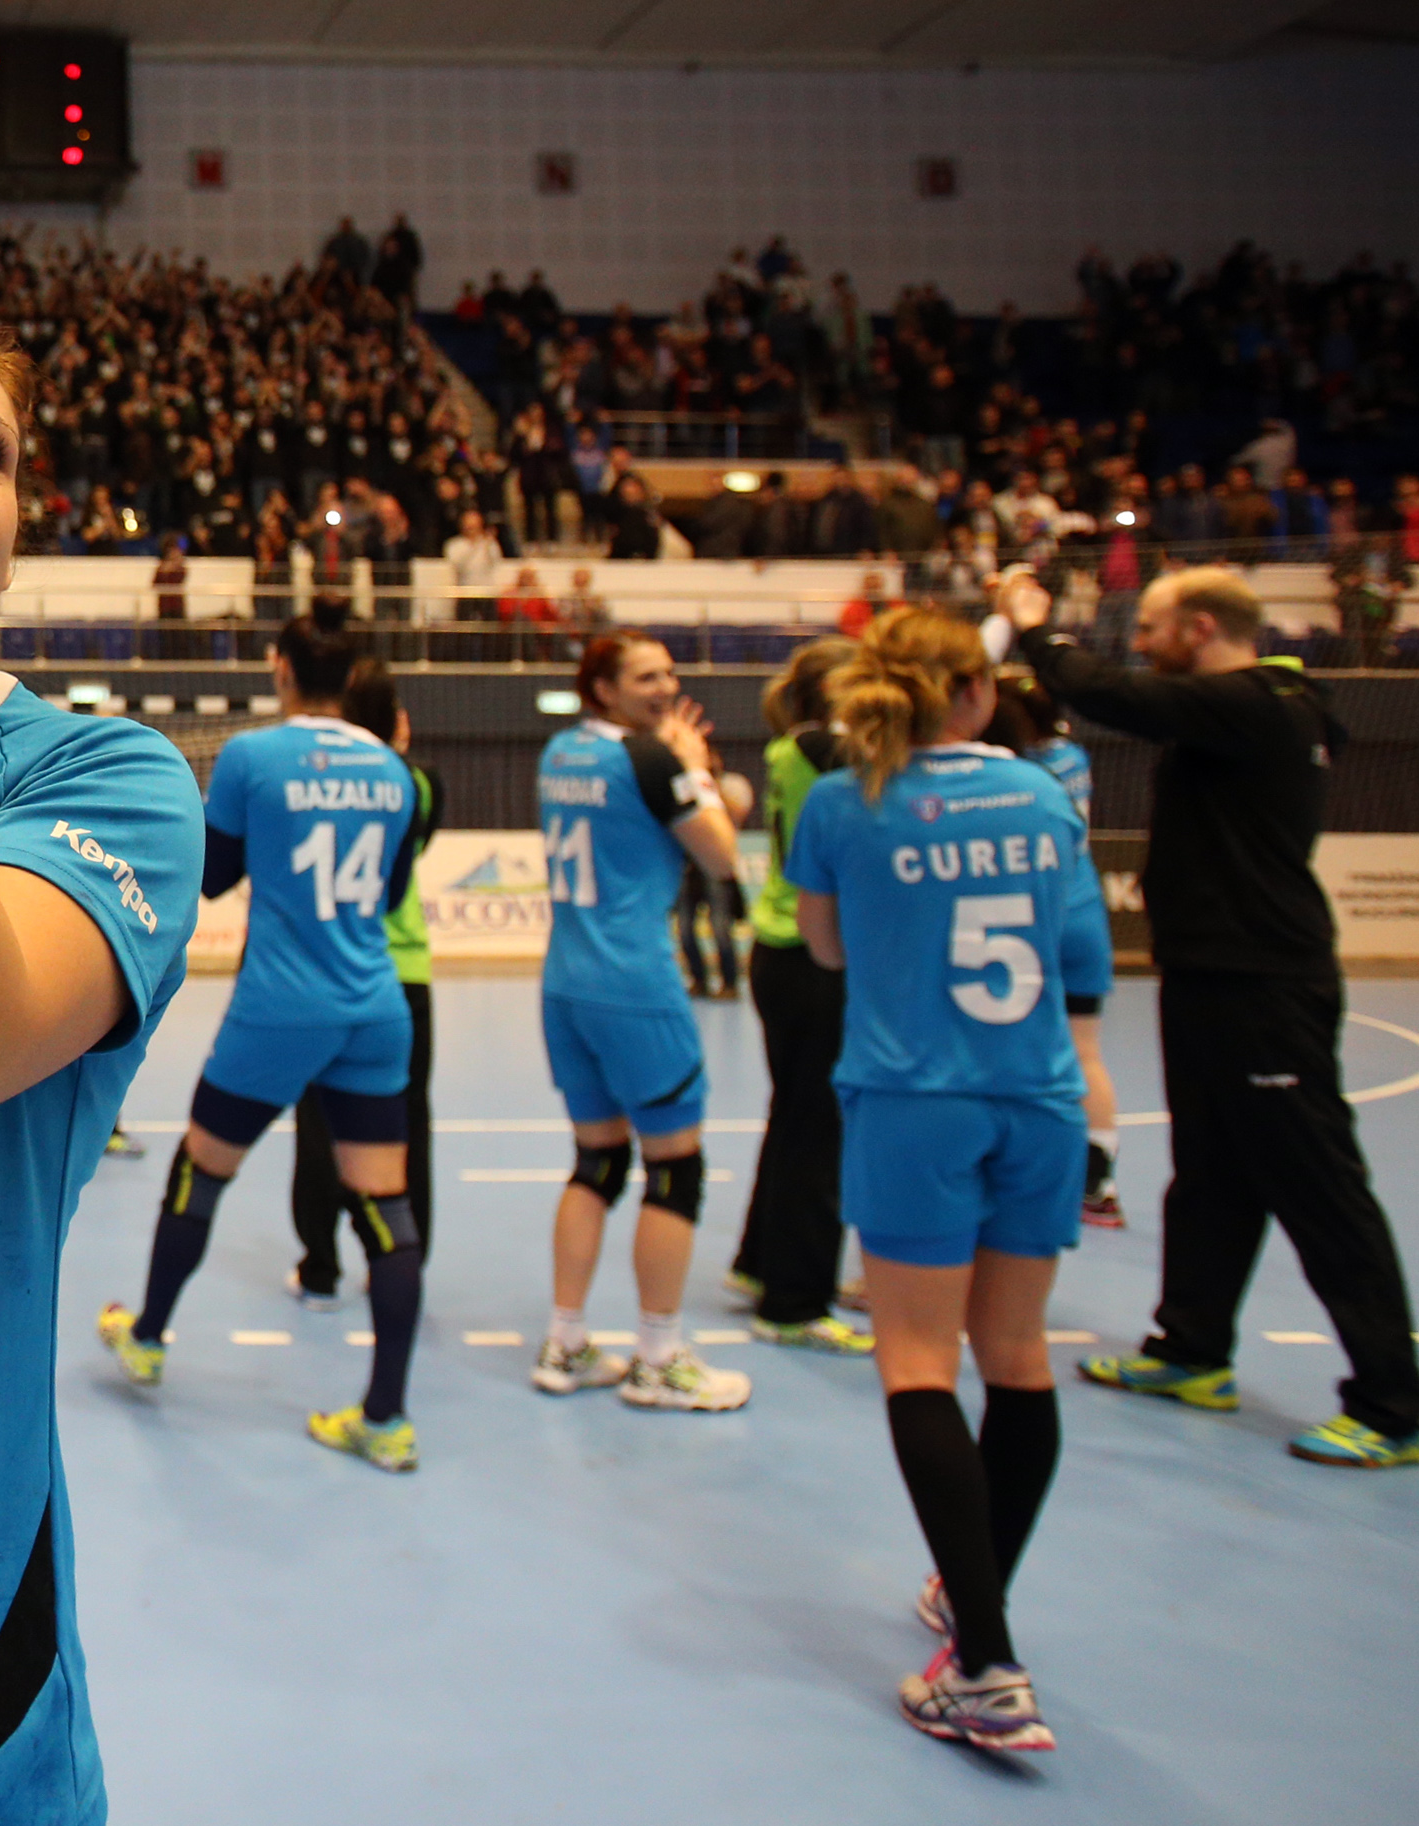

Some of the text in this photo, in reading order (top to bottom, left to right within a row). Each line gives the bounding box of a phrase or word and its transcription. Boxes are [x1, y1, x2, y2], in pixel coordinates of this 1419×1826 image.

[285, 779, 403, 812] BAZALIU
[50, 820, 158, 935] Kempa
[292, 821, 385, 921] 14
[892, 832, 1059, 884] CUREA
[947, 893, 1043, 1024] 5
